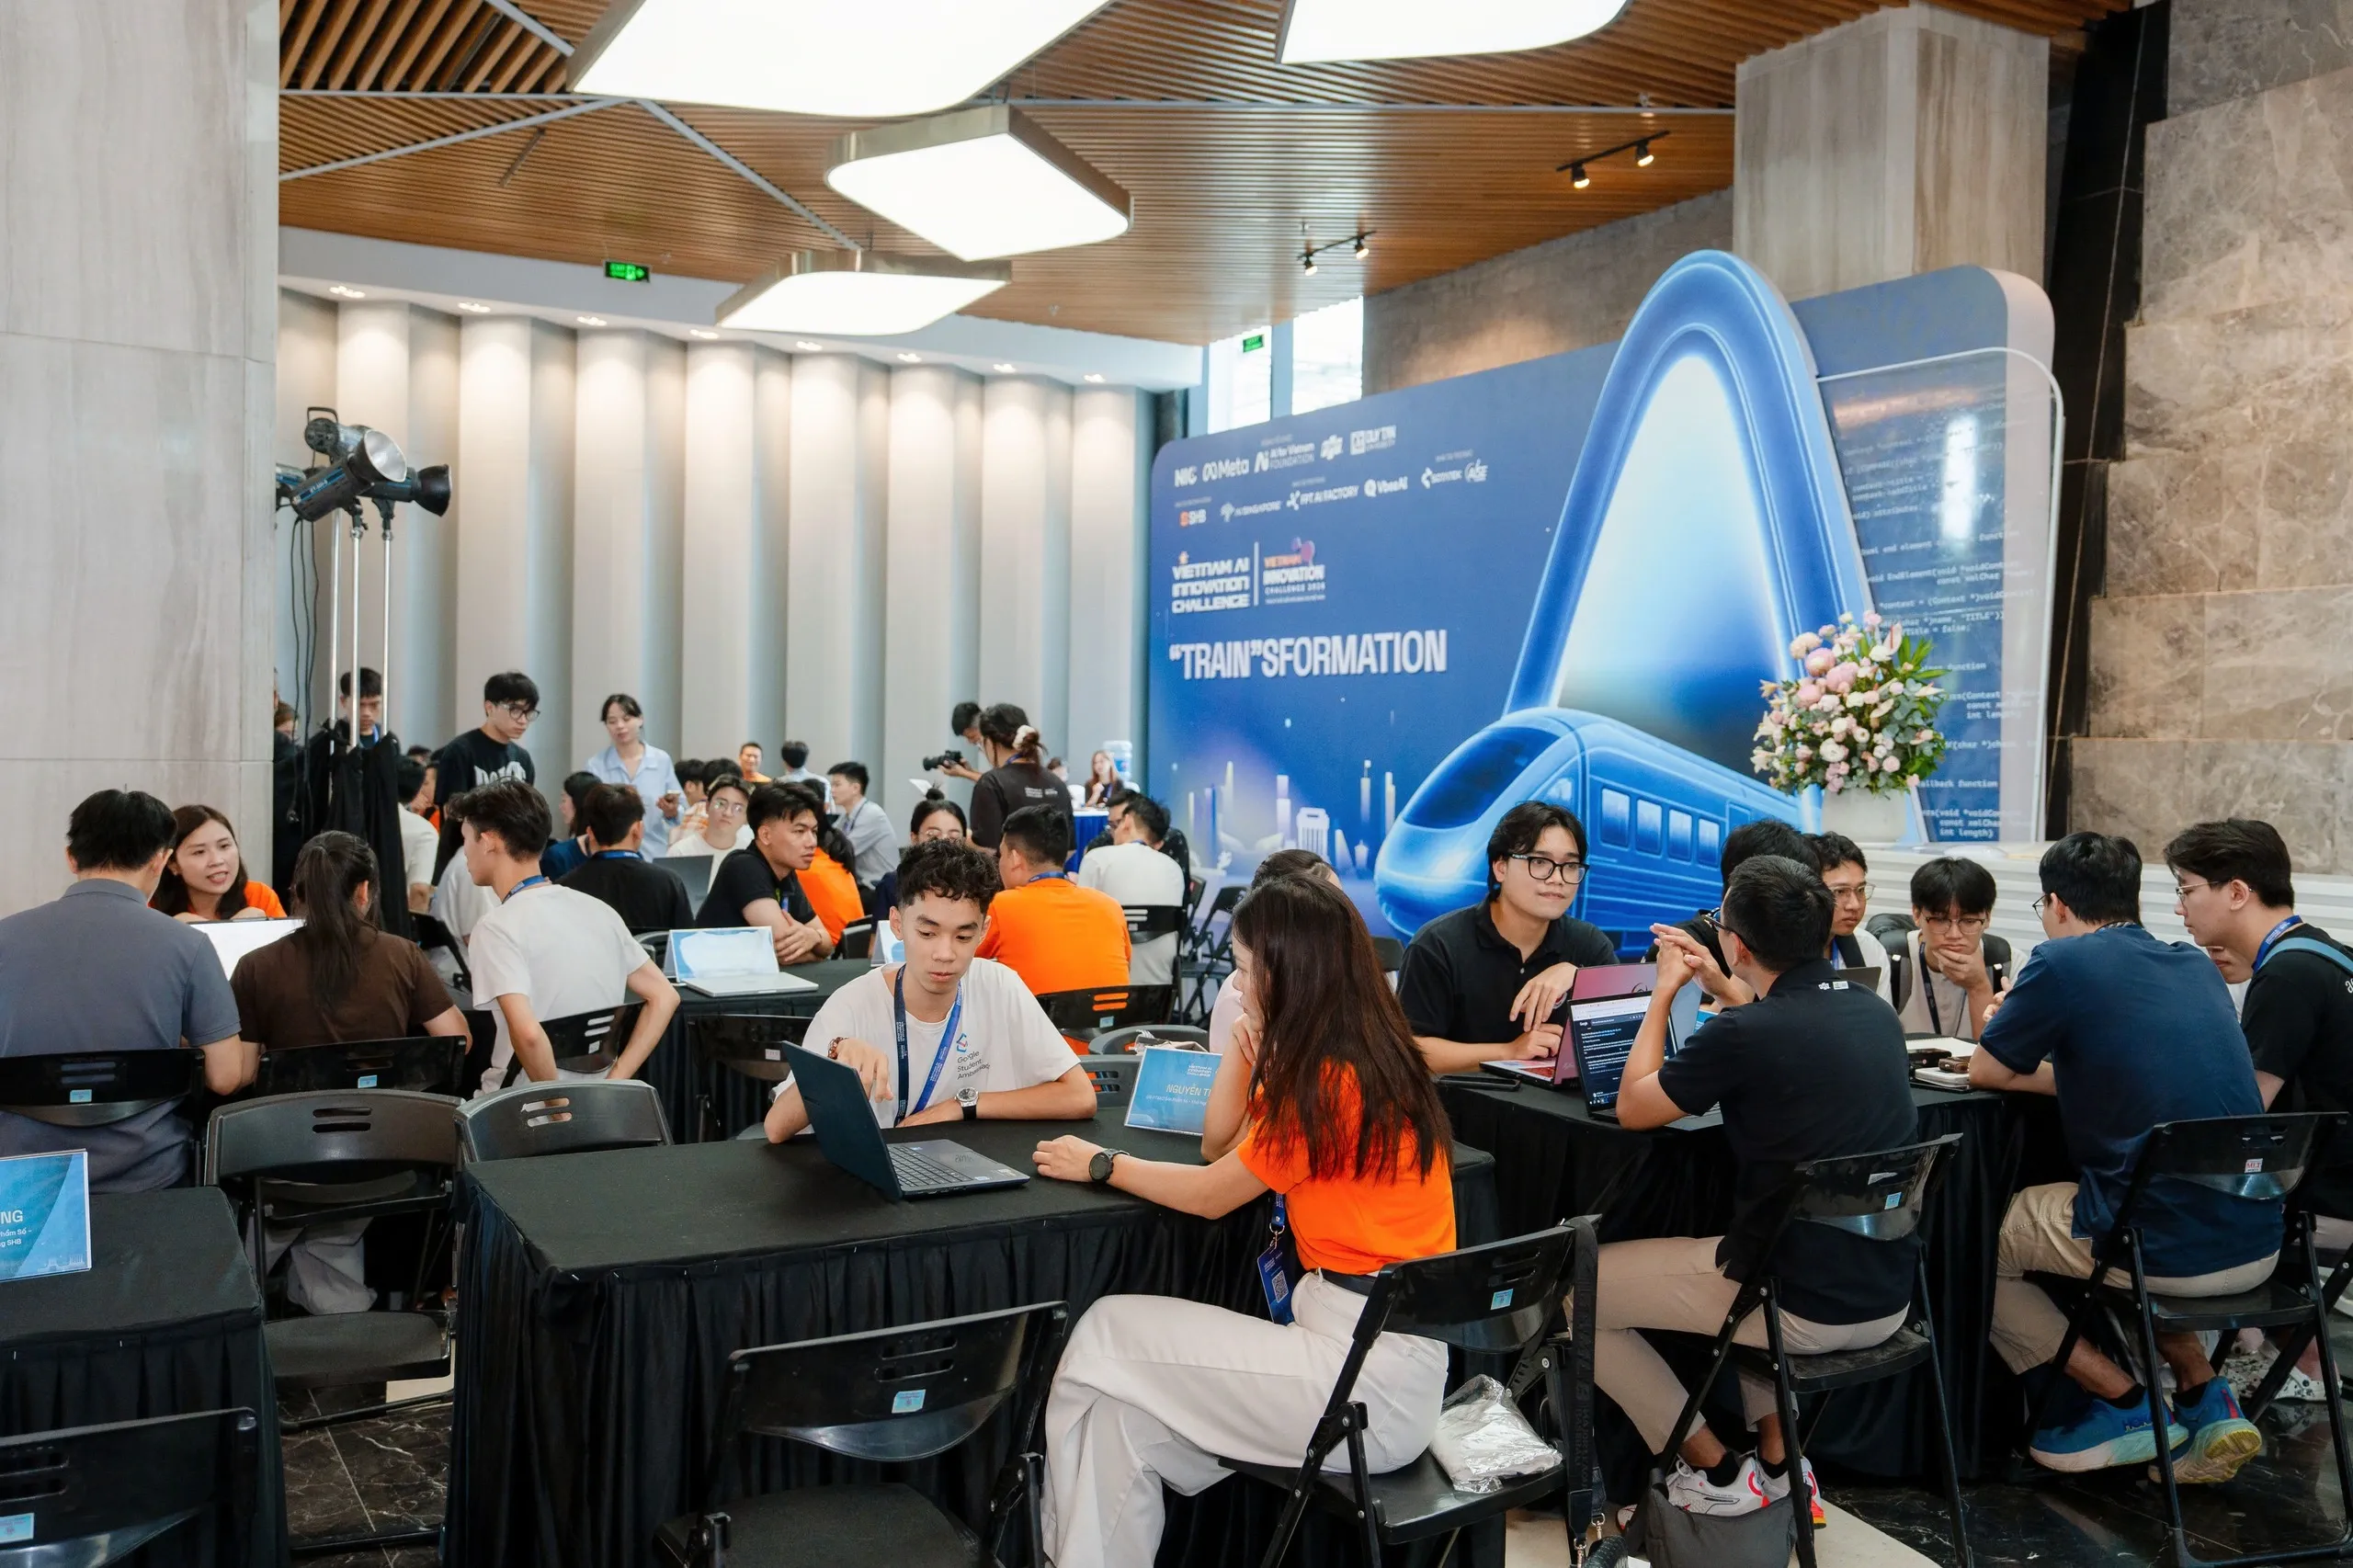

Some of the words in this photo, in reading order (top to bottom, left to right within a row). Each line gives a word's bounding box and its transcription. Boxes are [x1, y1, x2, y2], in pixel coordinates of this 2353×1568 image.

[1218, 457, 1250, 479] Meta
[1188, 508, 1207, 526] SHB
[1172, 559, 1233, 581] VIETNAM
[1233, 557, 1250, 574] AI
[1263, 564, 1325, 585] INNOVATION
[1172, 575, 1250, 597] INNOVATION
[1172, 594, 1250, 614] CHALLENGE
[1947, 662, 1987, 671] function
[1967, 711, 1982, 720] int
[1958, 778, 1998, 789] function
[1938, 819, 1964, 827] const
[1938, 828, 1955, 836] int
[1959, 827, 1994, 838] length)
[957, 1059, 982, 1072] Student
[6, 1238, 22, 1246] SHB
